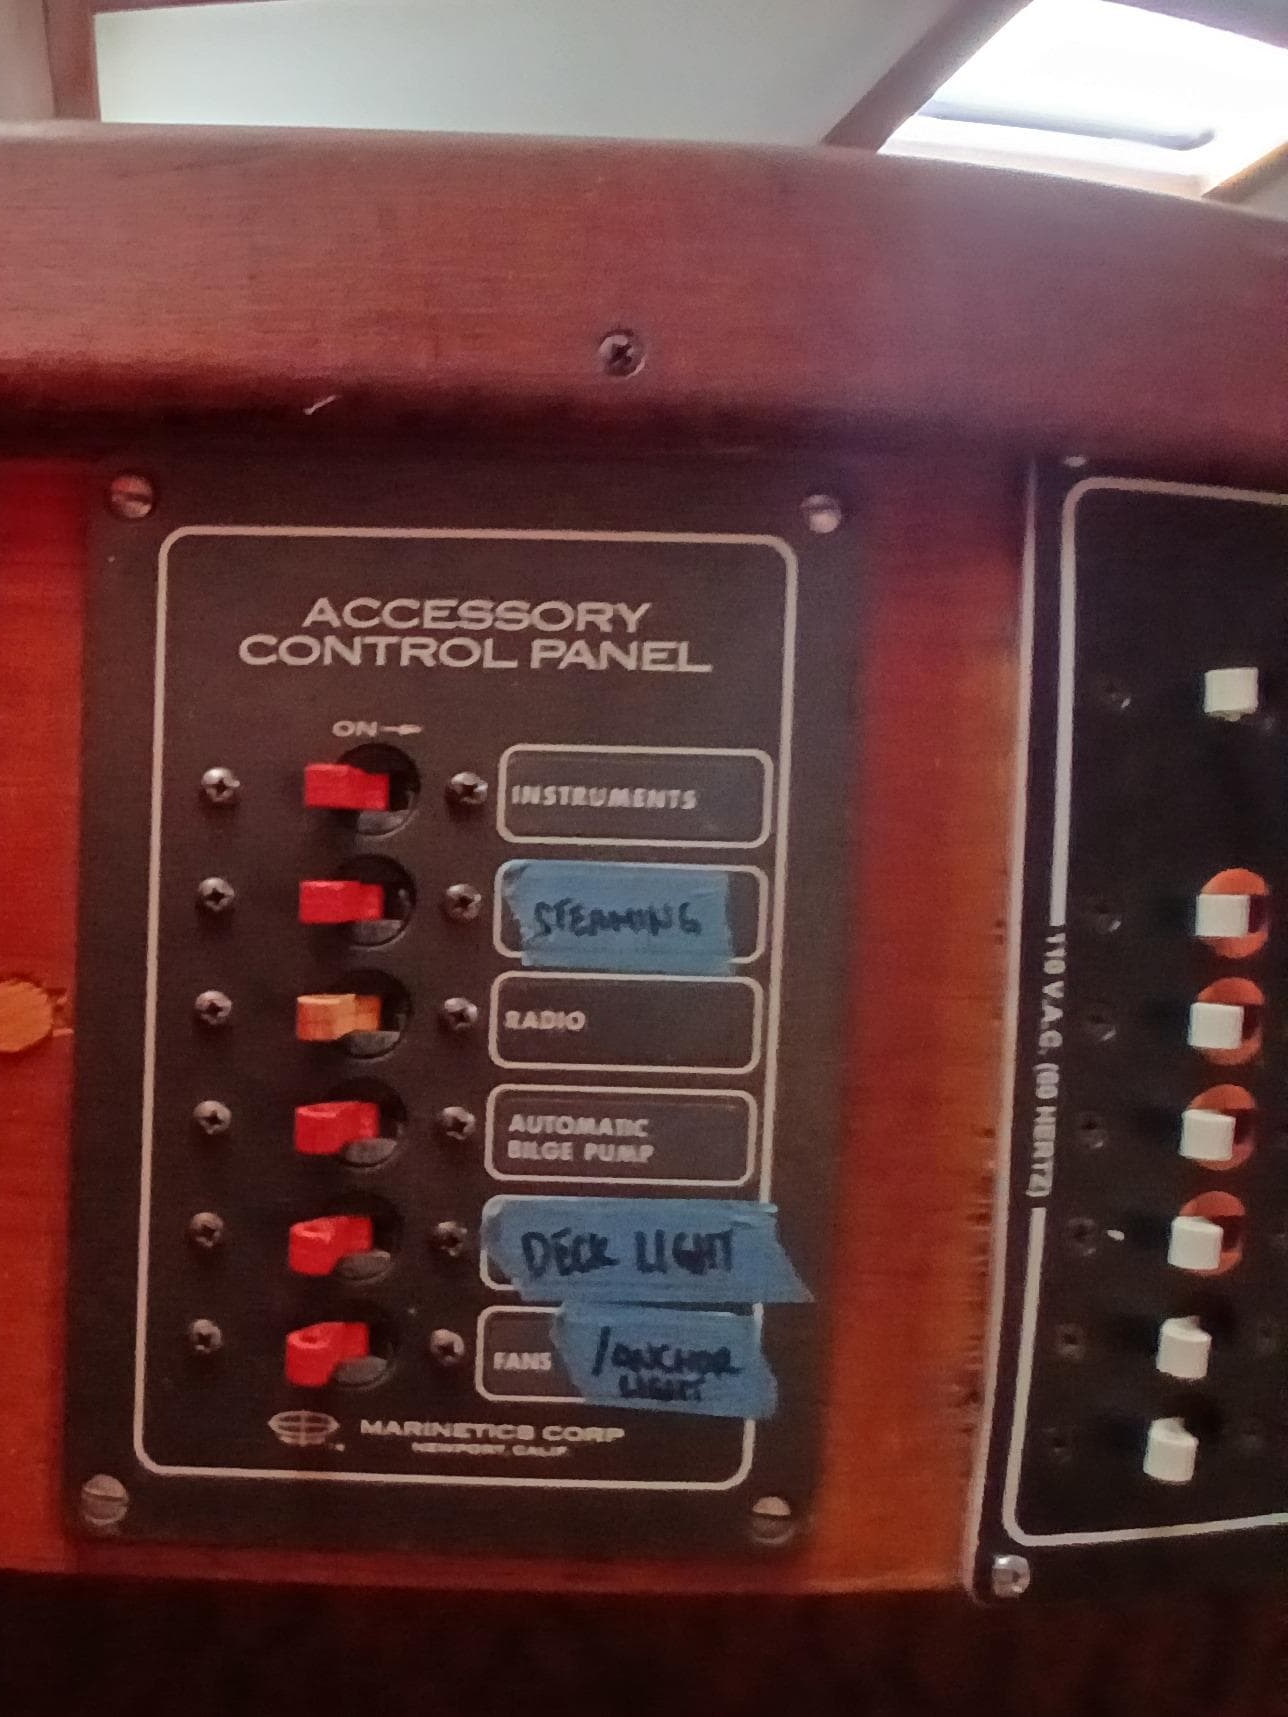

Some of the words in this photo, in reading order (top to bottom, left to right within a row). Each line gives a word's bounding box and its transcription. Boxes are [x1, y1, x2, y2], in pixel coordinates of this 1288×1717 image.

[303, 597, 652, 634] ACCESSORY
[238, 634, 517, 670] CONTROL
[530, 638, 713, 673] PANEL
[332, 720, 377, 737] ON
[512, 785, 698, 810] INSTRUMENTS
[505, 1010, 586, 1031] RADIO
[509, 1114, 650, 1138] AUTOMATIC
[507, 1140, 574, 1161] BILGE
[583, 1142, 655, 1164] PUMP
[521, 1227, 620, 1279] DECK
[634, 1228, 734, 1276] LIGHT
[493, 1351, 553, 1371] FANS
[359, 1418, 536, 1441] MARINETICS
[542, 1424, 626, 1443] CORP
